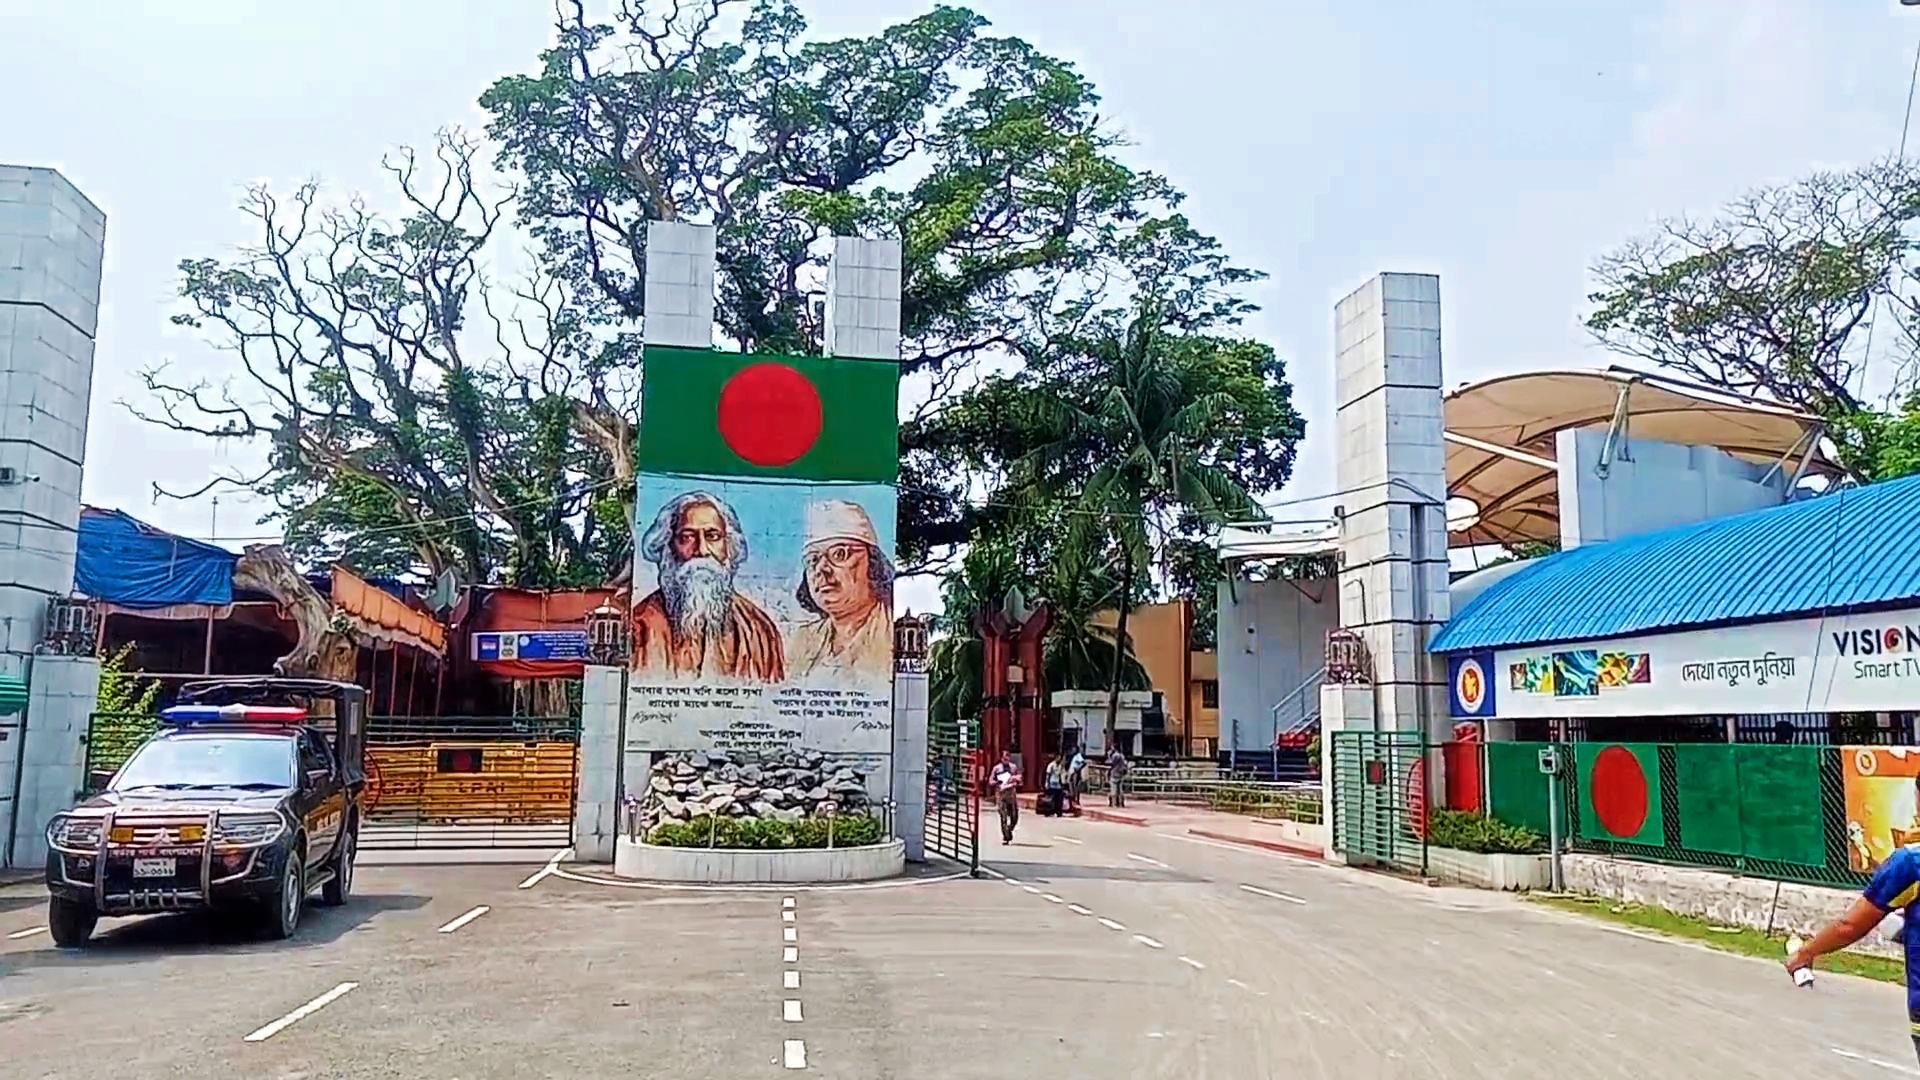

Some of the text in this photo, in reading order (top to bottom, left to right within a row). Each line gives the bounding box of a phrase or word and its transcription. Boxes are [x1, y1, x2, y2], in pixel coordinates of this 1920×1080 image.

[1832, 625, 1920, 657] VISION
[1681, 651, 1795, 687] দেখো নতুন দুনিয়া
[1854, 660, 1900, 679] Smart
